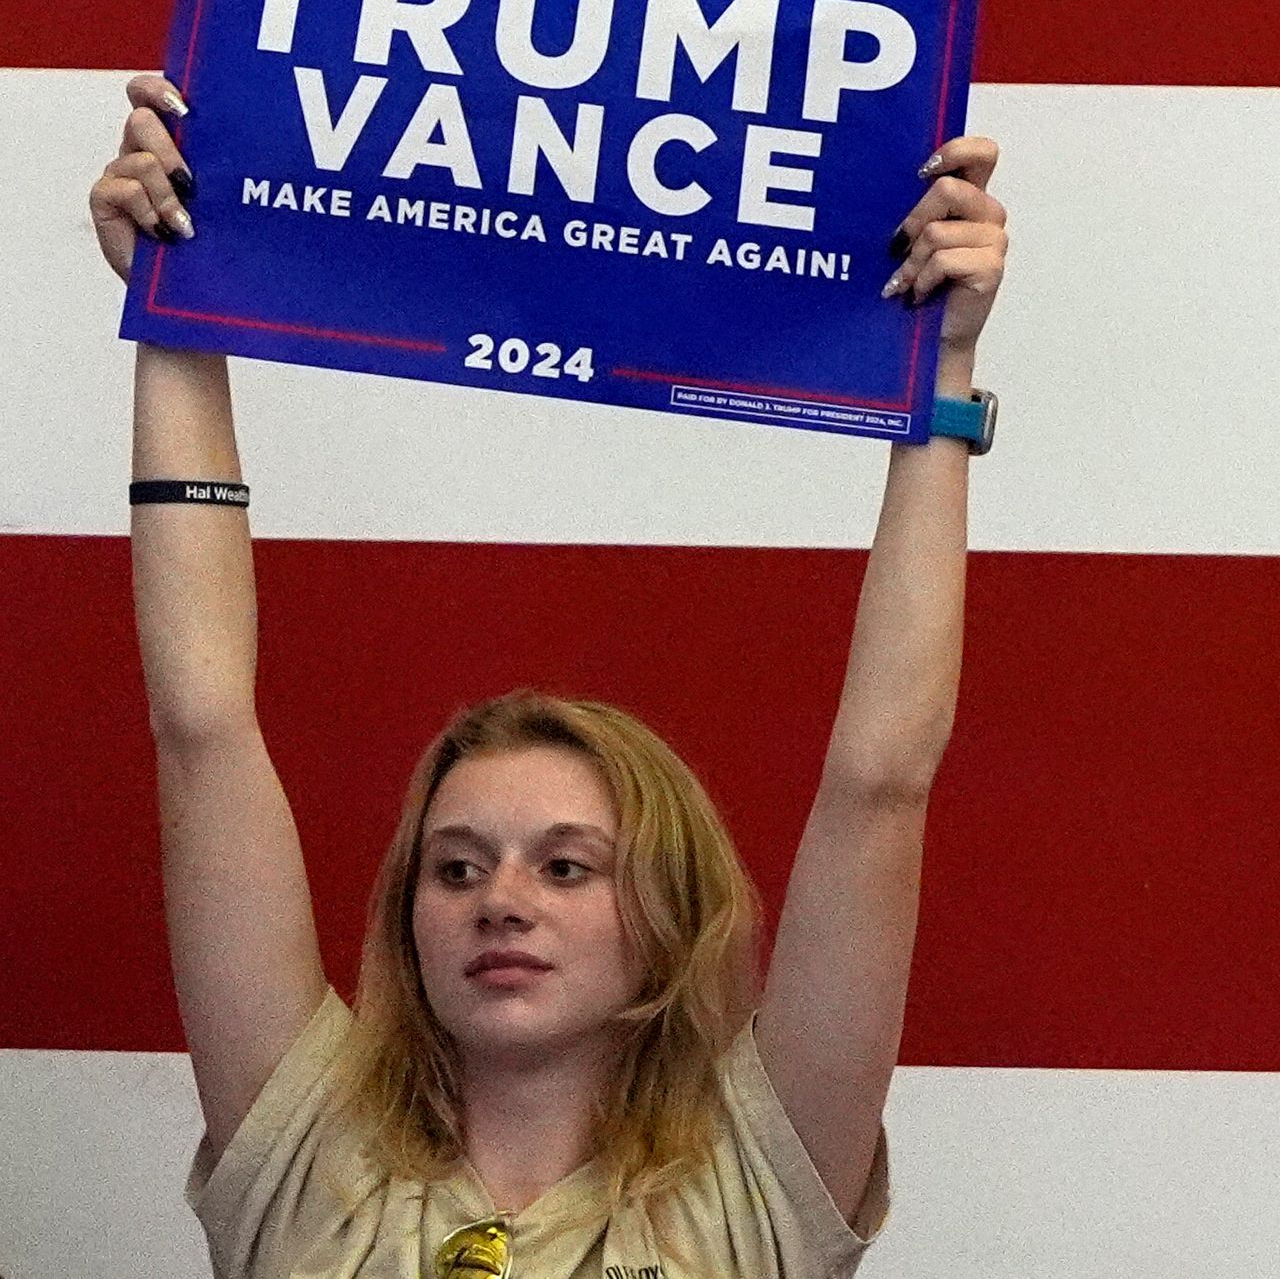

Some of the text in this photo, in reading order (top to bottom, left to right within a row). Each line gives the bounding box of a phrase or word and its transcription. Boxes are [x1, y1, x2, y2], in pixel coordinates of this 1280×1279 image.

[294, 67, 822, 231] VANCE
[243, 178, 852, 282] MAKE AMERICA GREAT AGAIN!
[465, 334, 595, 383] 2024
[677, 392, 697, 401] PAID
[698, 395, 715, 403] FOR
[729, 399, 764, 410] DONALD
[773, 404, 801, 413] TRUMP
[802, 408, 819, 416] FOR
[820, 411, 864, 422] PRESIDENT
[186, 485, 211, 500] Hal
